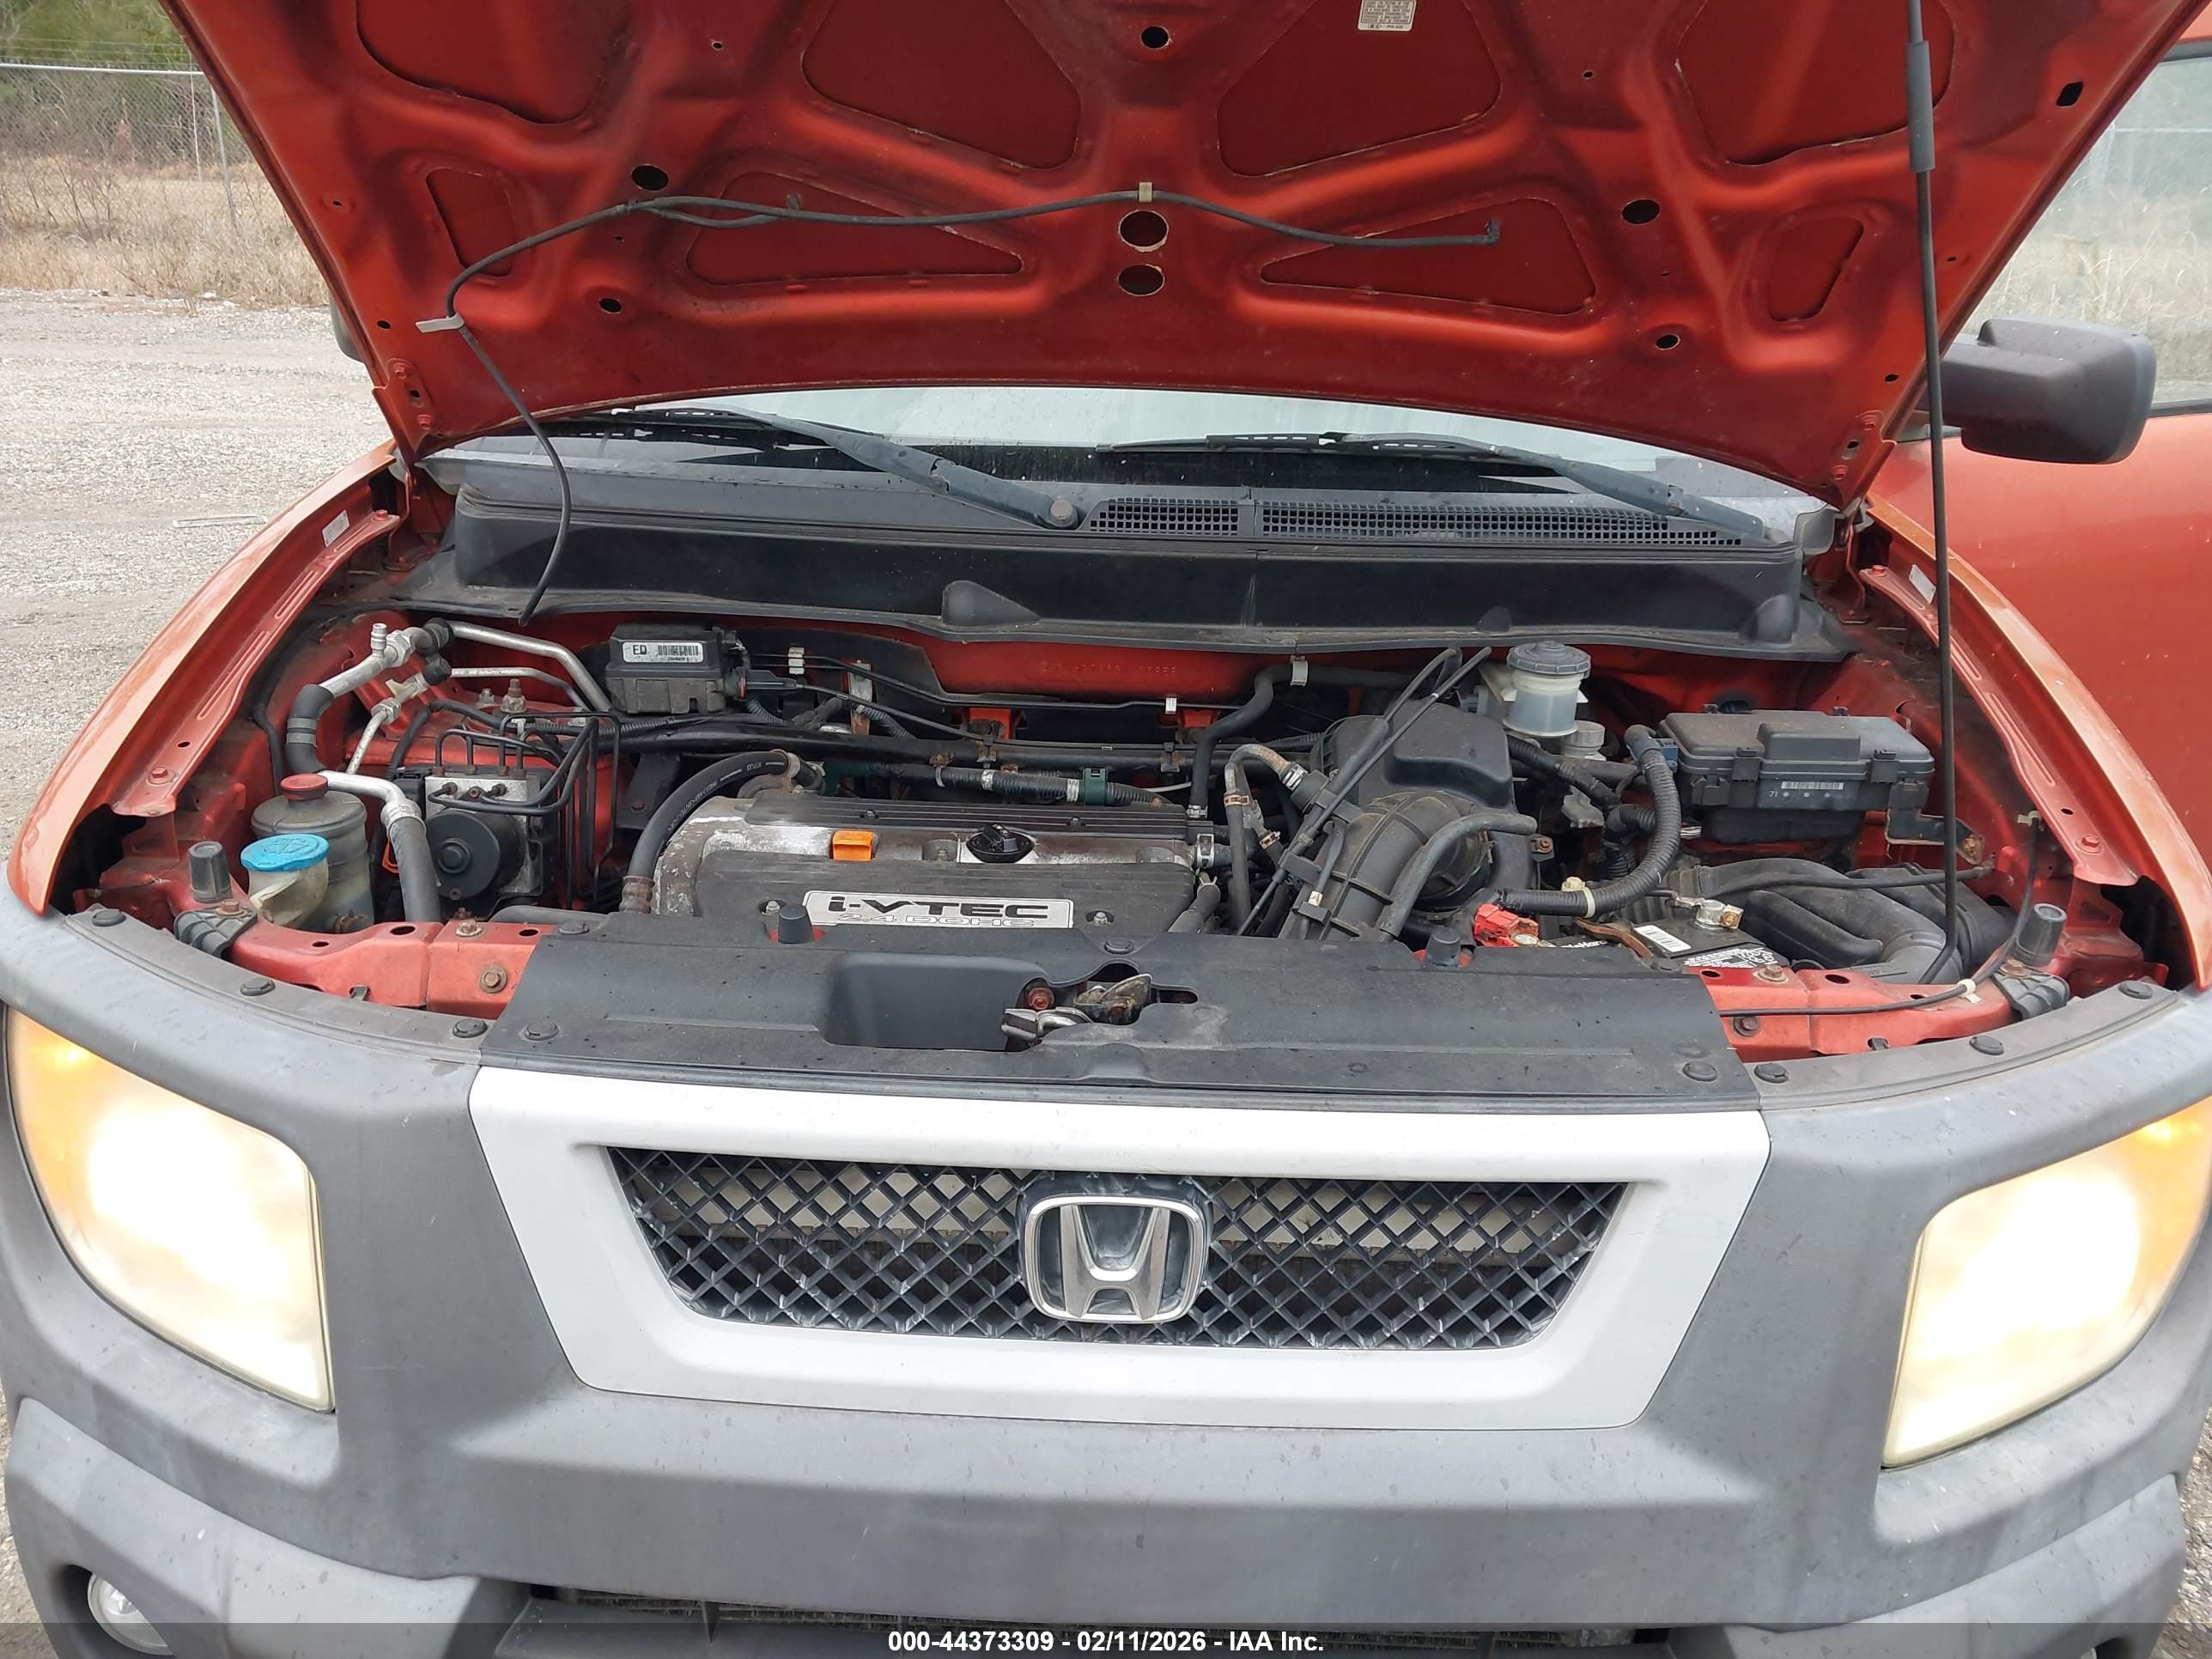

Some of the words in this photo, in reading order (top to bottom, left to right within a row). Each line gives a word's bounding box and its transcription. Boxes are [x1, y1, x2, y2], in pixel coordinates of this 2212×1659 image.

[828, 896, 1049, 919] i-VTEC
[838, 914, 897, 923] 2.4
[906, 915, 1035, 927] DOHC
